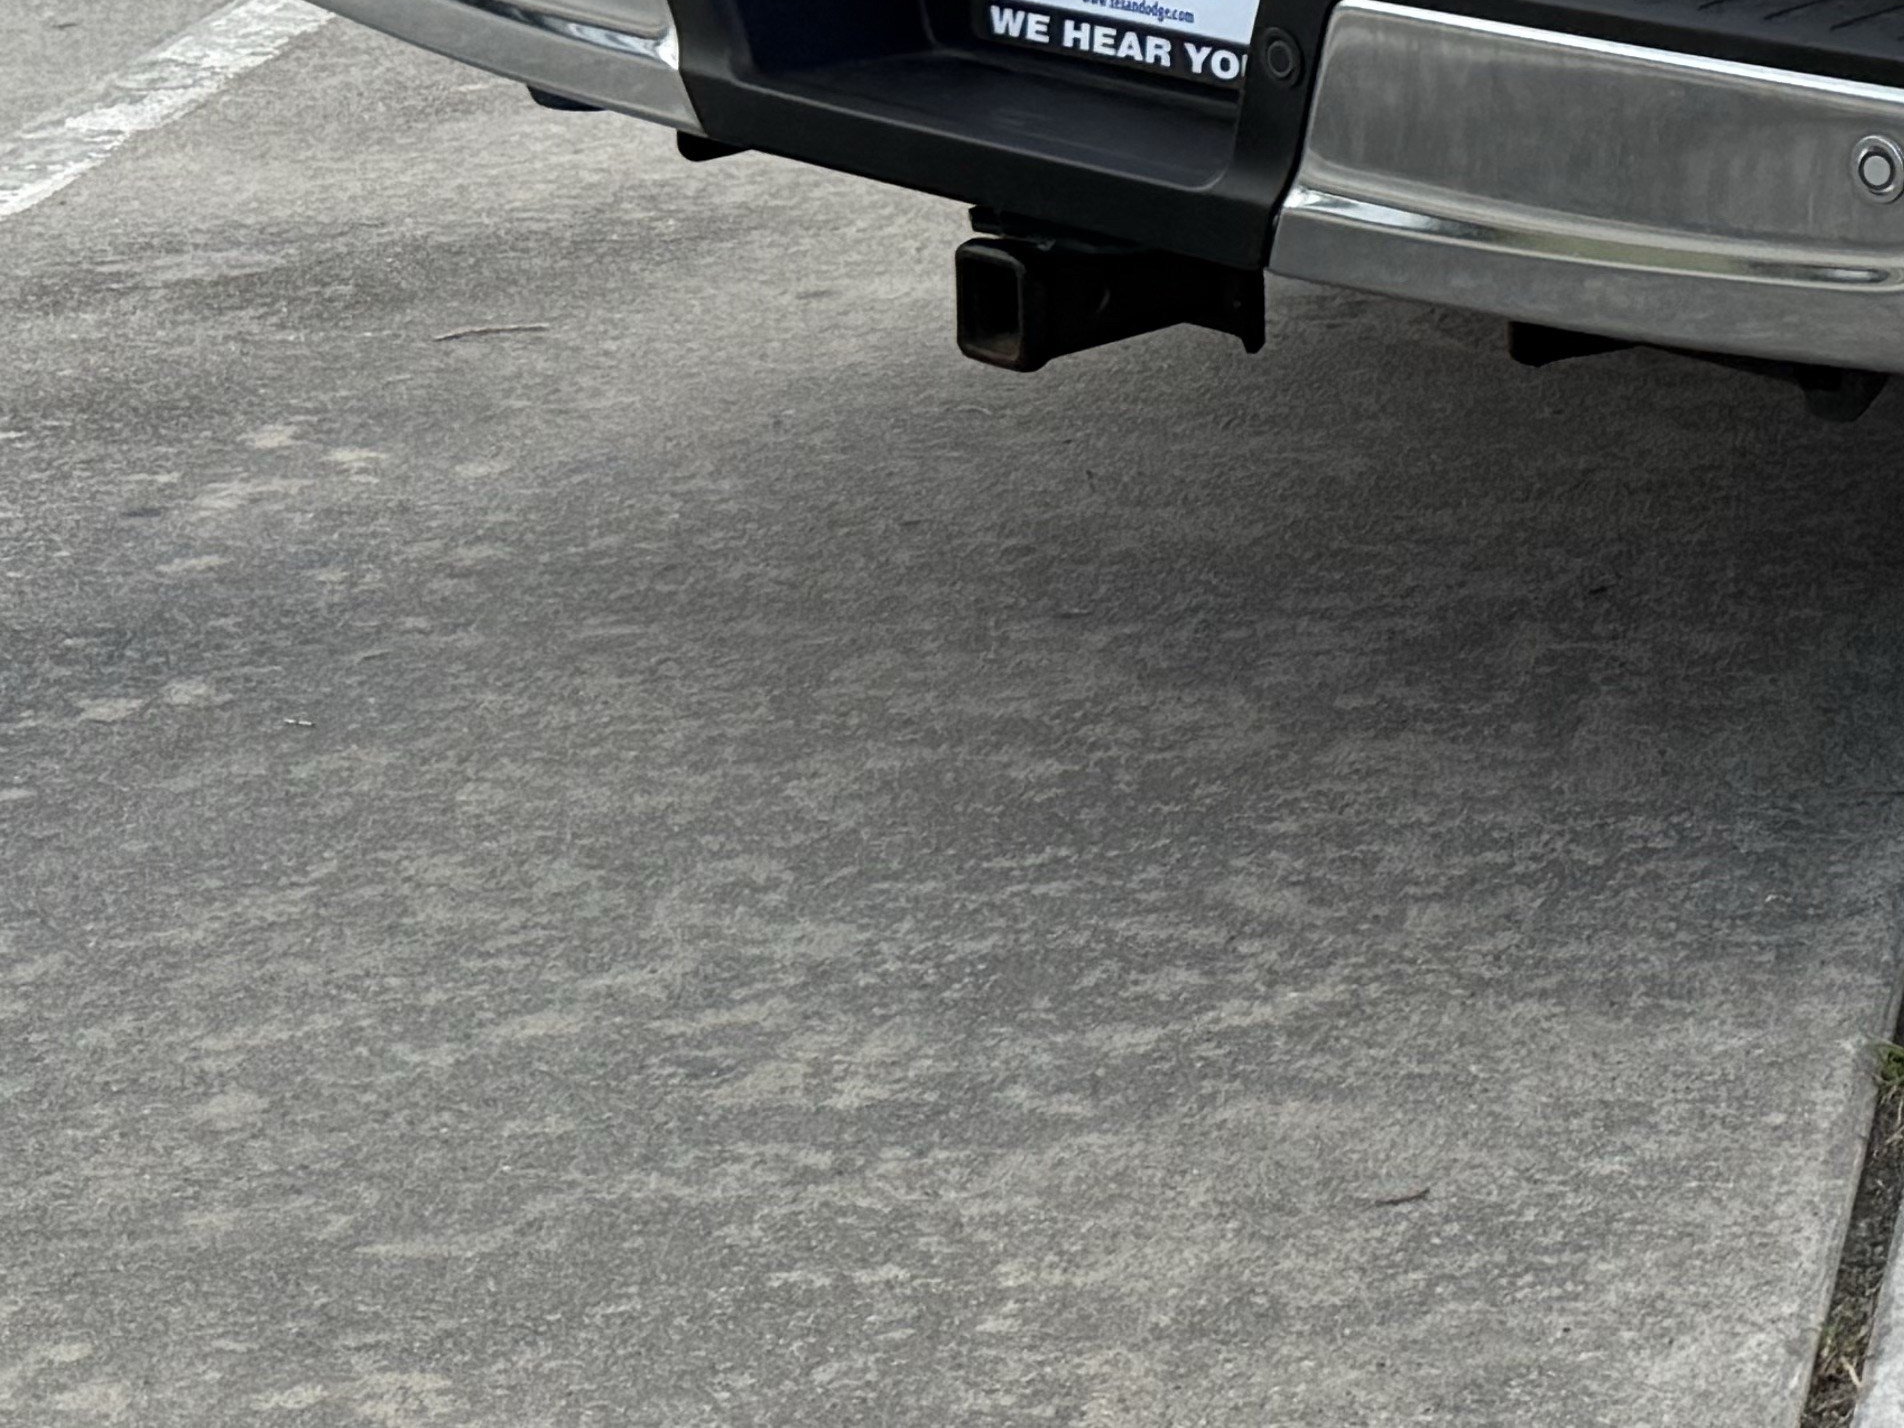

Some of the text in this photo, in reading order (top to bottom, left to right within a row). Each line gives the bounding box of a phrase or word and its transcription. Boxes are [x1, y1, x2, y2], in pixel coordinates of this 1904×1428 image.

[990, 5, 1248, 80] WE HEAR YO
